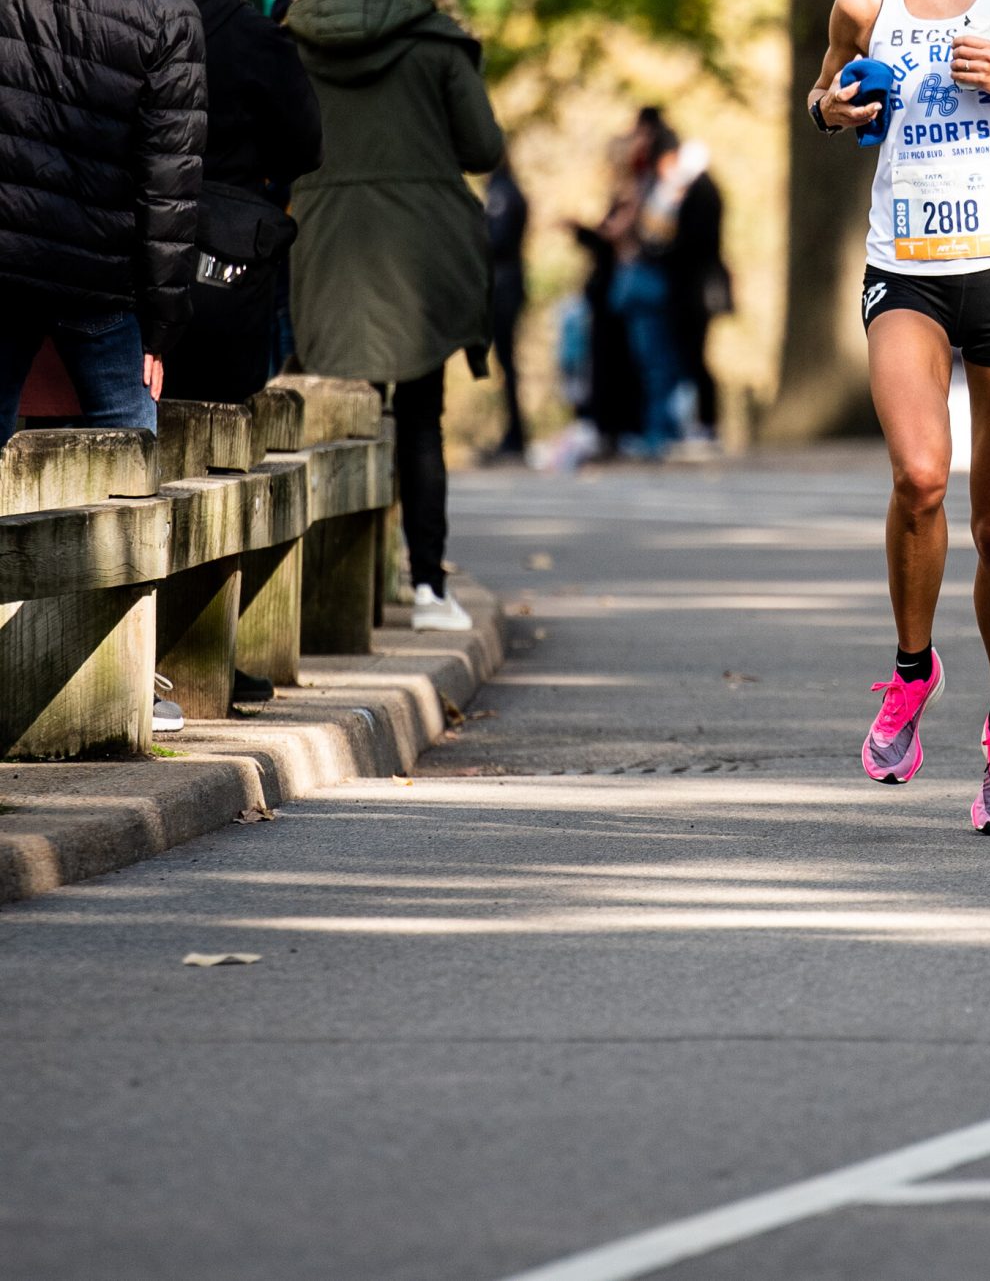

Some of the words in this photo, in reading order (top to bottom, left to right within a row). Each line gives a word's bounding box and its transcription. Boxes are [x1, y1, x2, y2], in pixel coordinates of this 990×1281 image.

[889, 51, 919, 111] BLUE
[903, 119, 990, 145] SPORTS
[911, 150, 925, 159] PICO
[952, 147, 973, 156] SANTA
[897, 202, 907, 235] 2019
[923, 200, 979, 234] 2818
